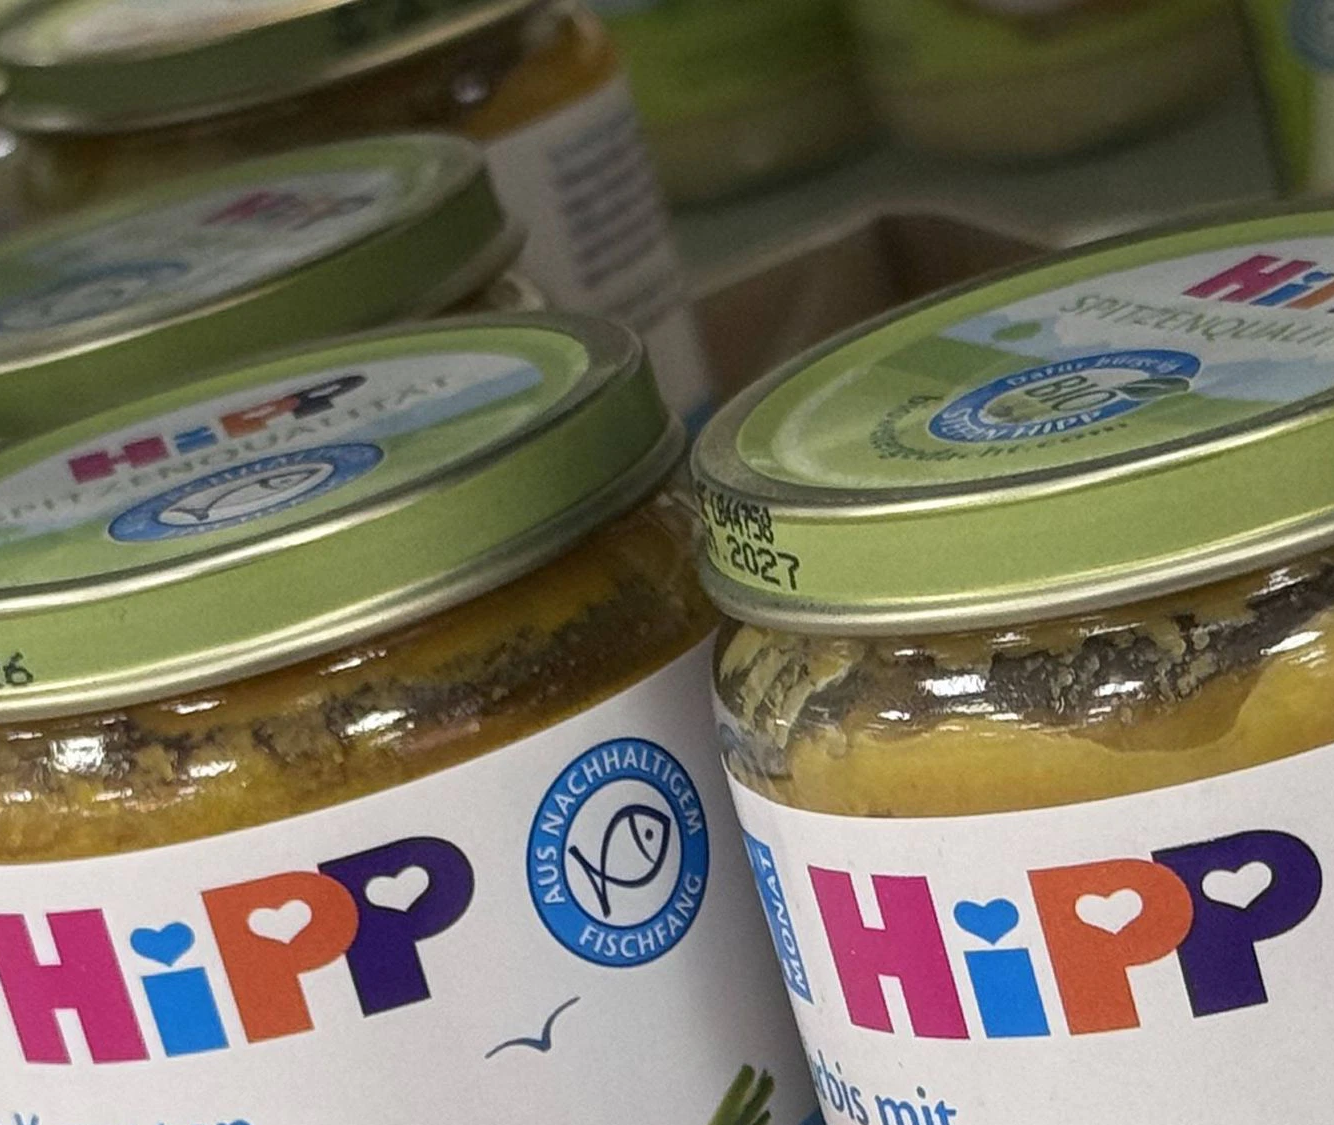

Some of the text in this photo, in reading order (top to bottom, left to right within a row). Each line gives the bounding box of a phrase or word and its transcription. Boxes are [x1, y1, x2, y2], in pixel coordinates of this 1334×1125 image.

[69, 374, 368, 484] HiPP
[1025, 375, 1118, 412] BIO
[536, 745, 703, 906] AUS NACHHALTIGEM
[579, 872, 703, 958] FISCHFANG
[759, 848, 809, 994] MONAT
[807, 829, 1324, 1040] HiPP
